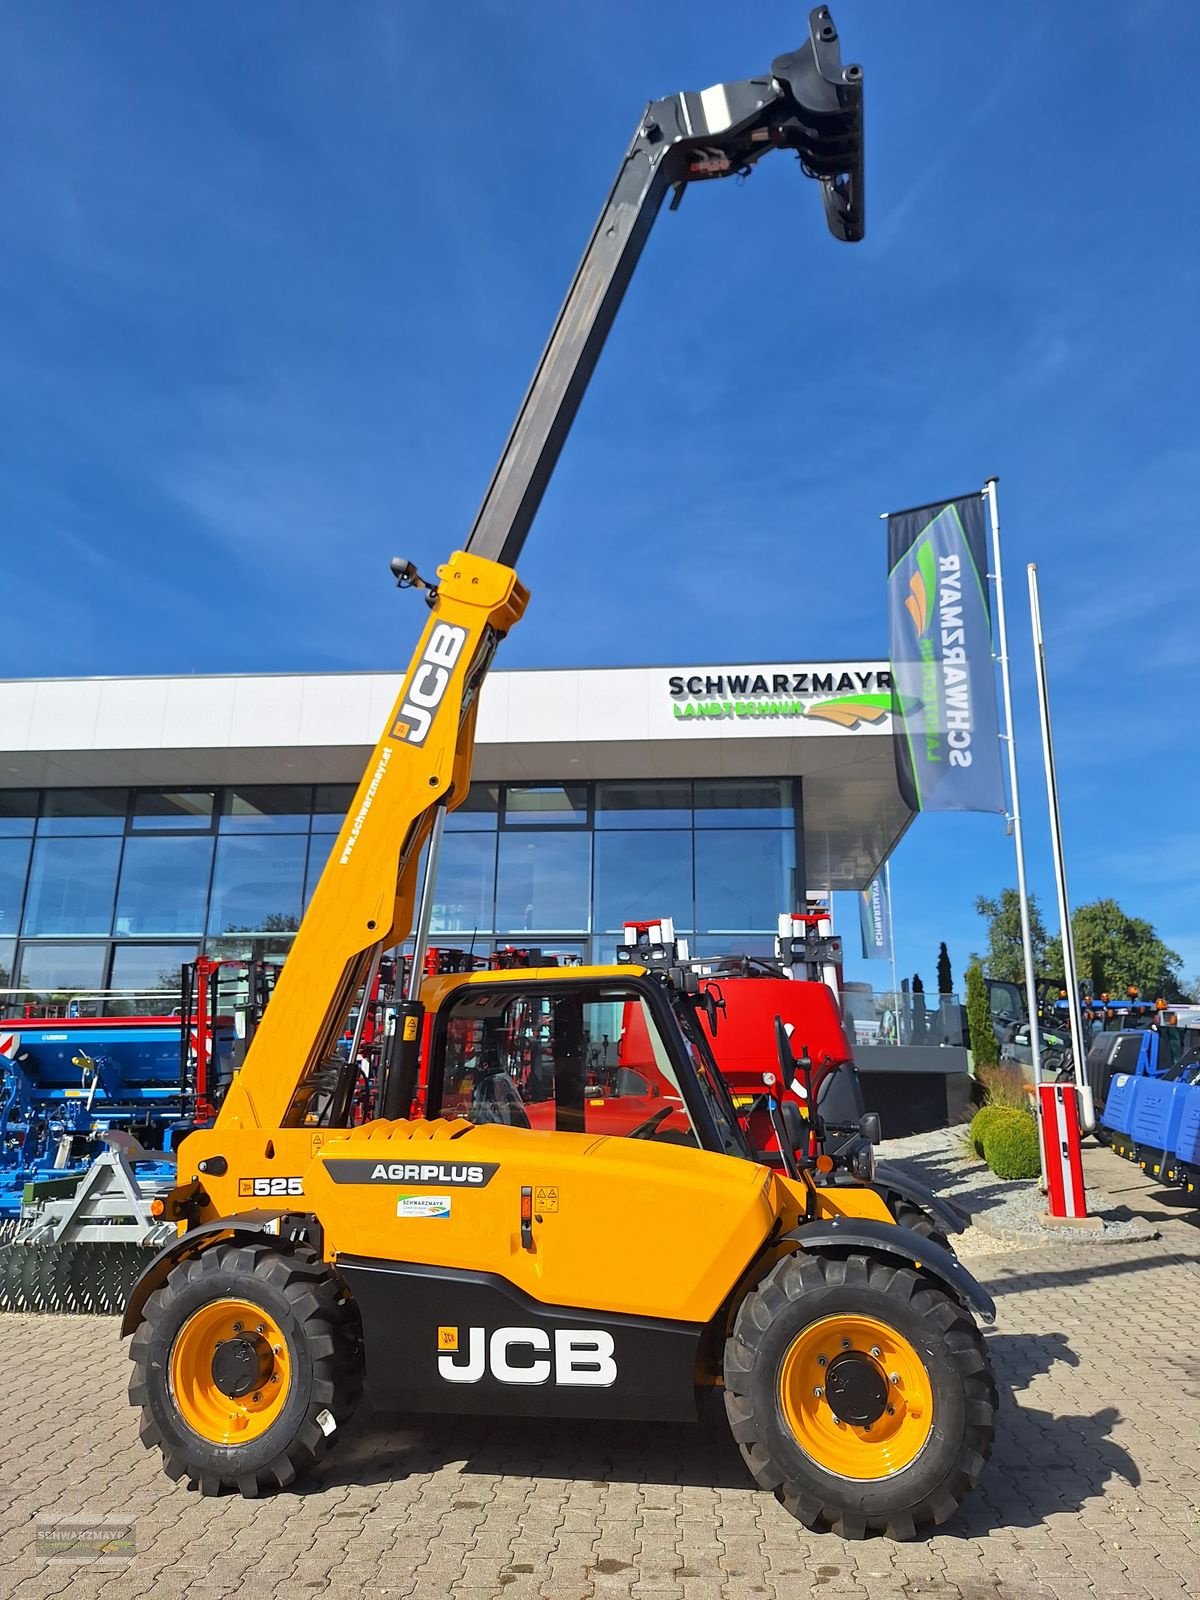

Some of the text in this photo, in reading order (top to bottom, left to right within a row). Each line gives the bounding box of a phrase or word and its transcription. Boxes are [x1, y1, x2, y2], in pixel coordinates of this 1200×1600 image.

[401, 623, 469, 743] JCB
[668, 671, 894, 696] SCHWARZMAYR
[673, 700, 803, 718] LANDTECHNIK
[338, 746, 394, 865] www.schwarzmayr.at
[253, 1177, 305, 1197] 525
[437, 1326, 618, 1388] JCB
